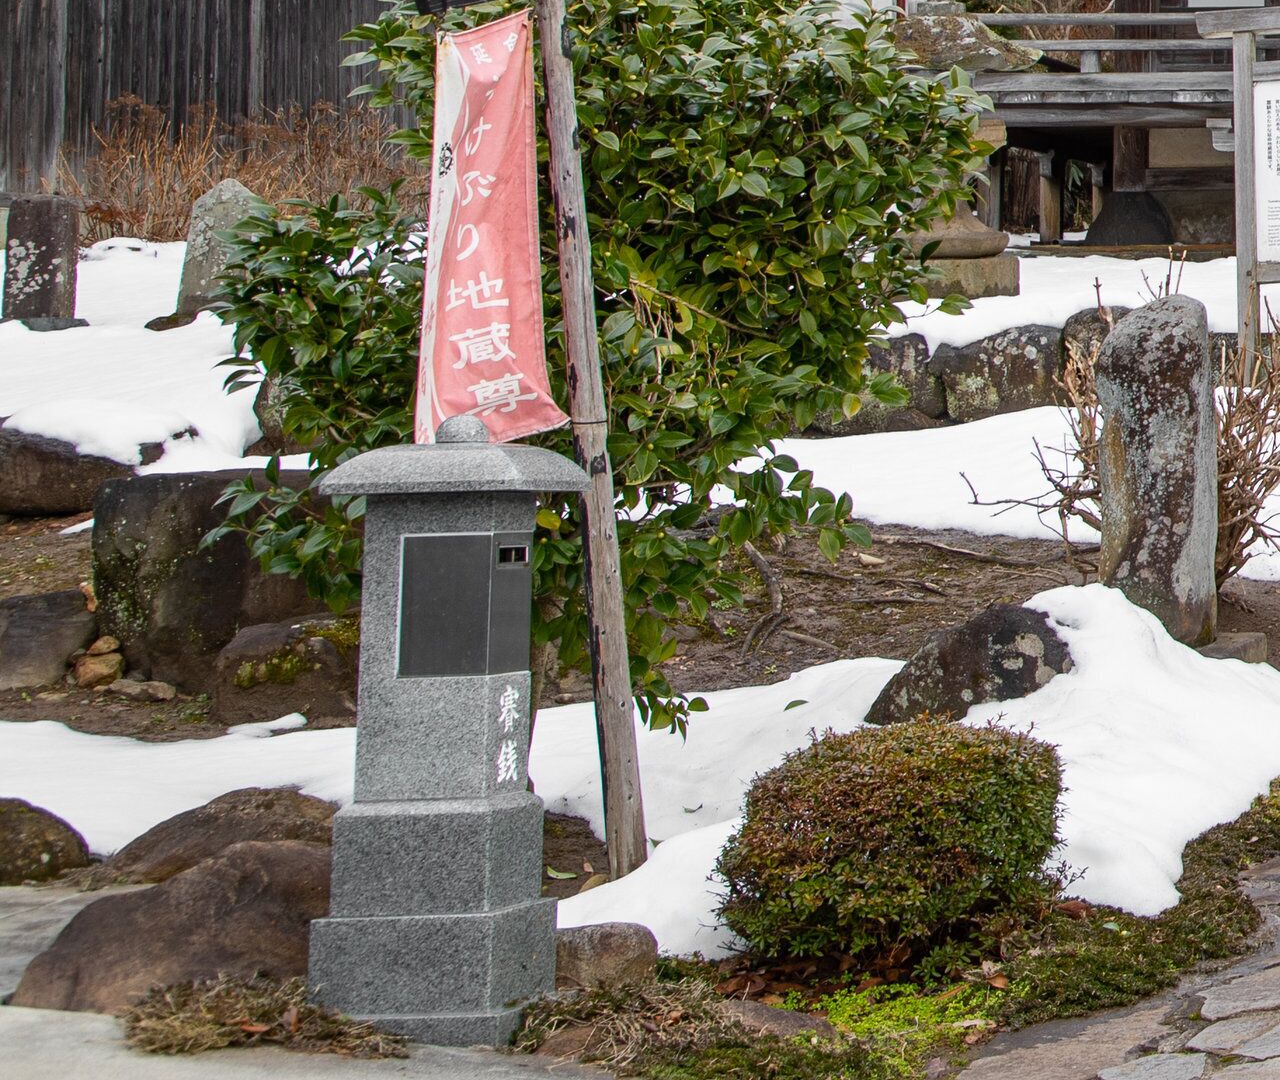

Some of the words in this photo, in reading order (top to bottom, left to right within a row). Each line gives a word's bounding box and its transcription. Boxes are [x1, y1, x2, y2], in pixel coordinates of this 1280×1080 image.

[444, 74, 538, 417] けぶり地蔵尊
